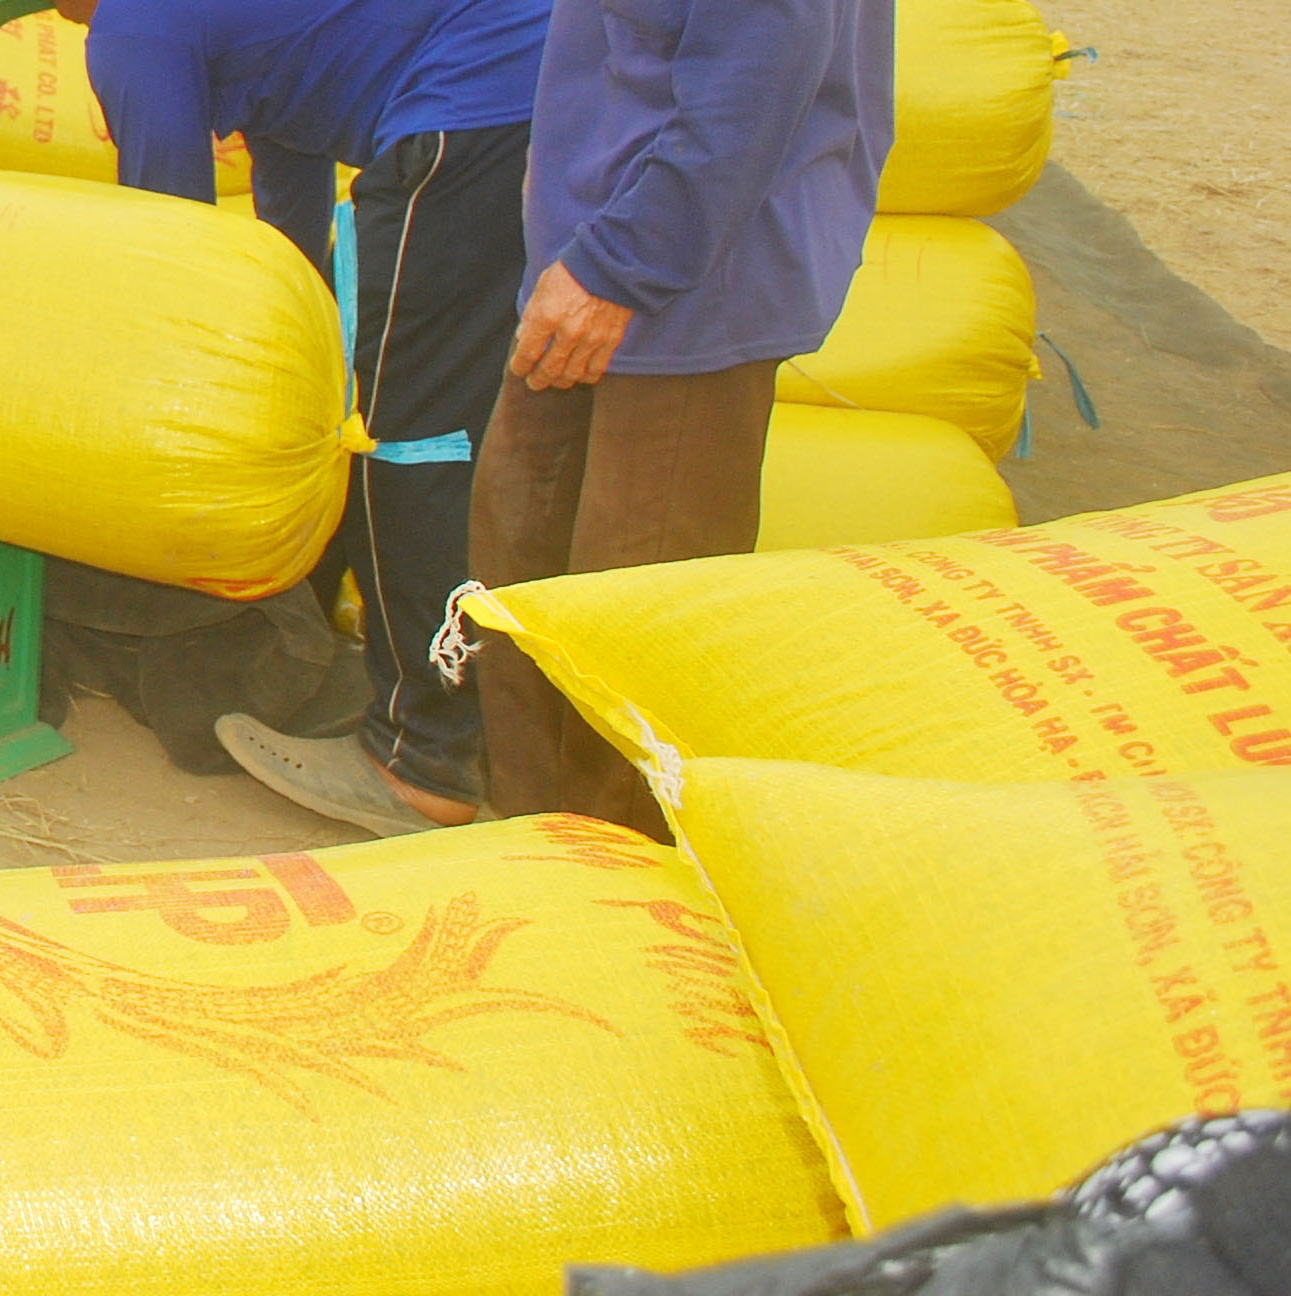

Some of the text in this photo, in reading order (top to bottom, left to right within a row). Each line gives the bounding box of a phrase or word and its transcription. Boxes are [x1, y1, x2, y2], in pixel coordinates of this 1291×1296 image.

[33, 106, 55, 144] LTD
[961, 579, 1007, 601] TY
[995, 601, 1065, 653] TNHH
[1045, 654, 1095, 686] SX
[1115, 606, 1260, 696] CHẤT
[1030, 715, 1080, 756] HẠ
[1220, 926, 1280, 973] TY
